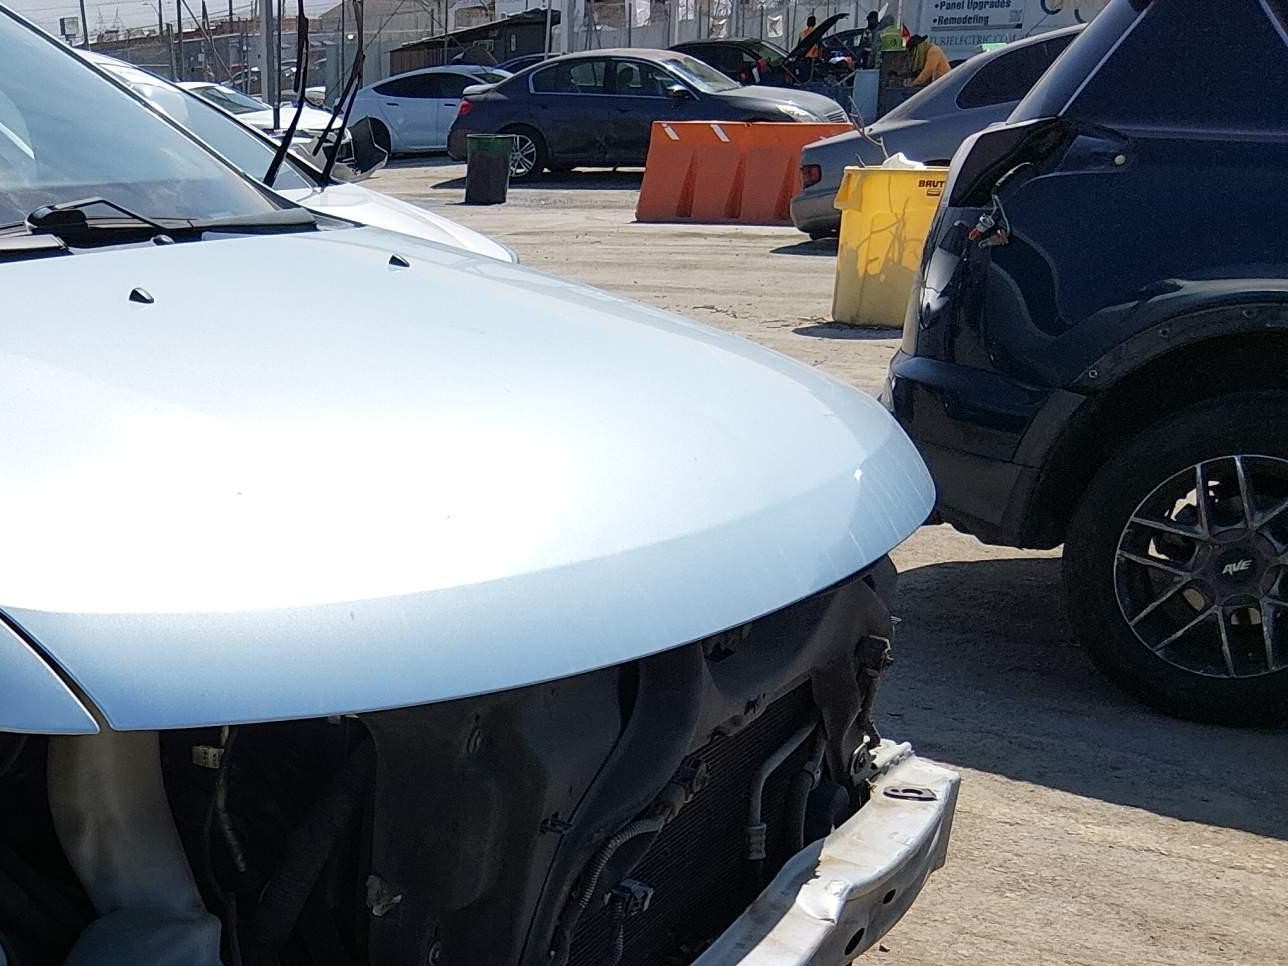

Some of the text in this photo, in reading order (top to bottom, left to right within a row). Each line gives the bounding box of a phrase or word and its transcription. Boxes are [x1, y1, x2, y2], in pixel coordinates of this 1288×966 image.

[940, 0, 1011, 11] Panel Upgrades
[938, 15, 989, 25] Remodeling
